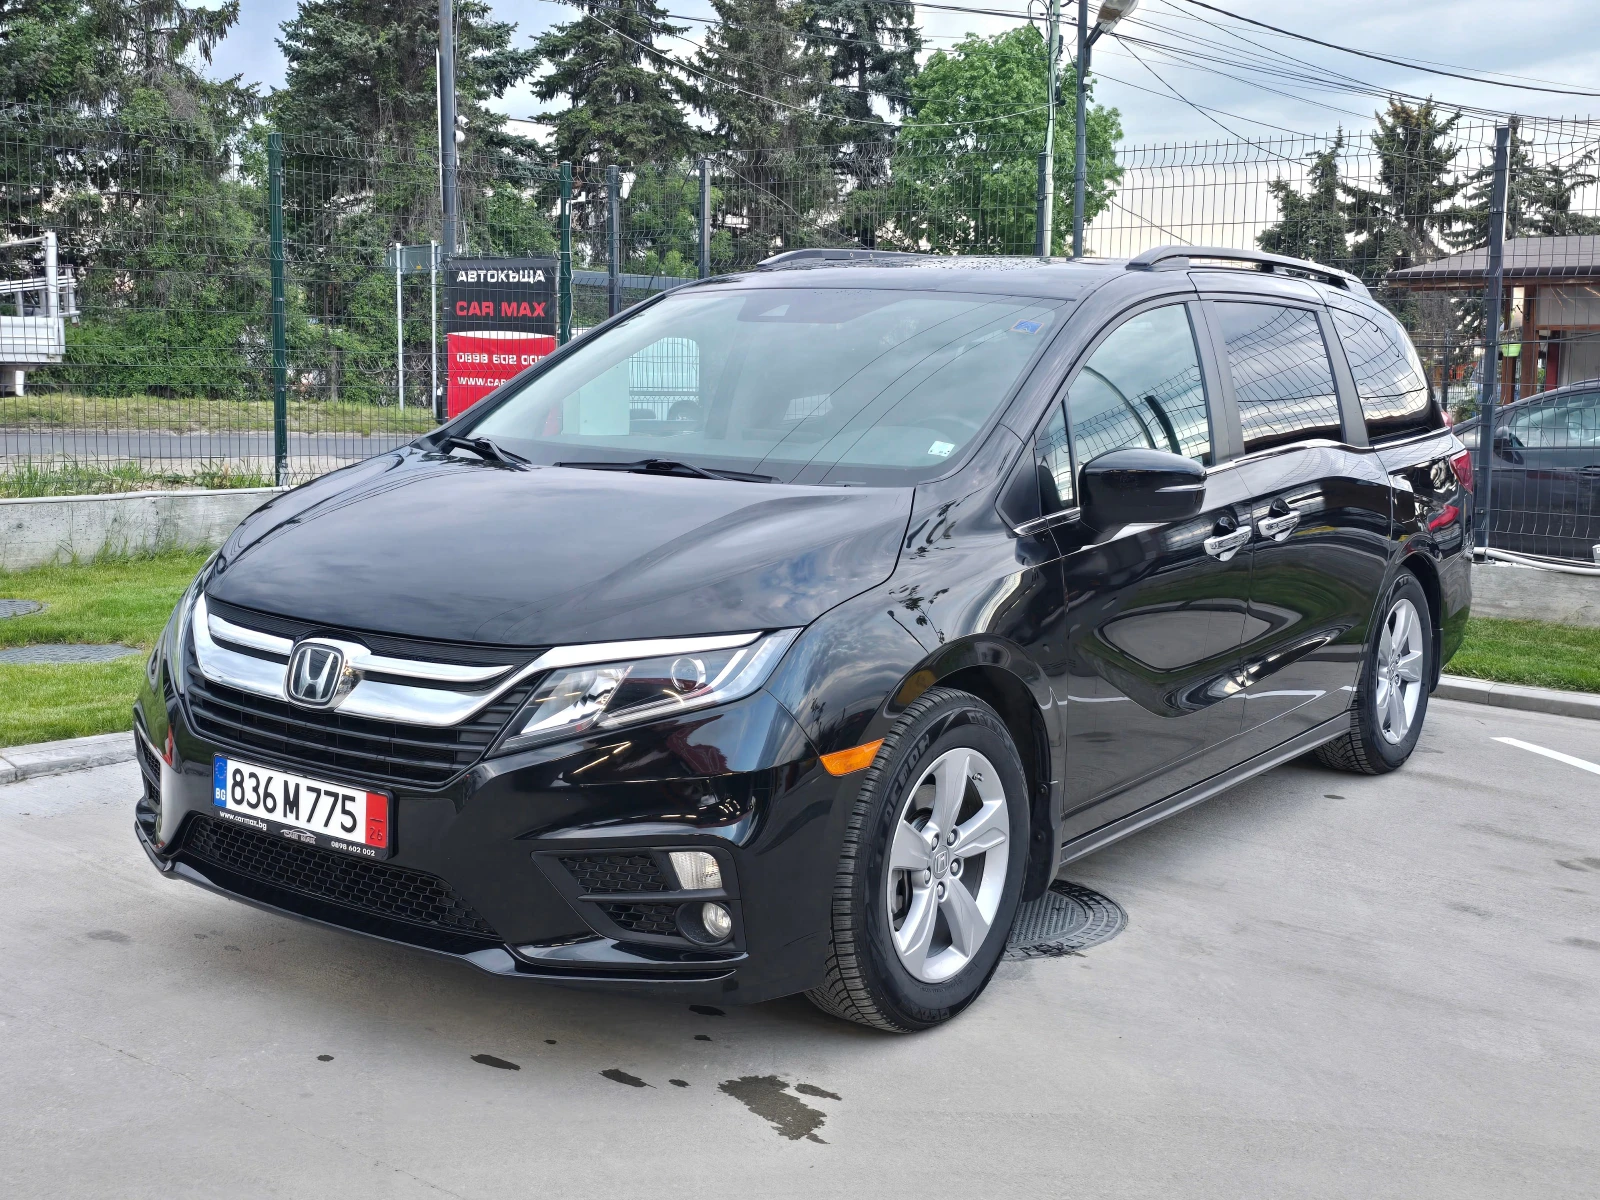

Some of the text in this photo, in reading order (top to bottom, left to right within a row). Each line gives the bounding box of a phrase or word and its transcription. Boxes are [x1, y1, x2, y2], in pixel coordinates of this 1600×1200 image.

[456, 269, 546, 284] АВТОКЪЩА
[455, 301, 546, 317] CAR MAX
[456, 352, 489, 364] 0898
[492, 354, 517, 365] 602
[457, 376, 512, 386] WWW.CAR
[215, 787, 226, 801] BG
[231, 768, 357, 834] 836 M 775
[219, 810, 267, 831] www.carmax.bg
[369, 826, 383, 841] 26
[348, 845, 361, 854] 602
[362, 848, 376, 857] 002
